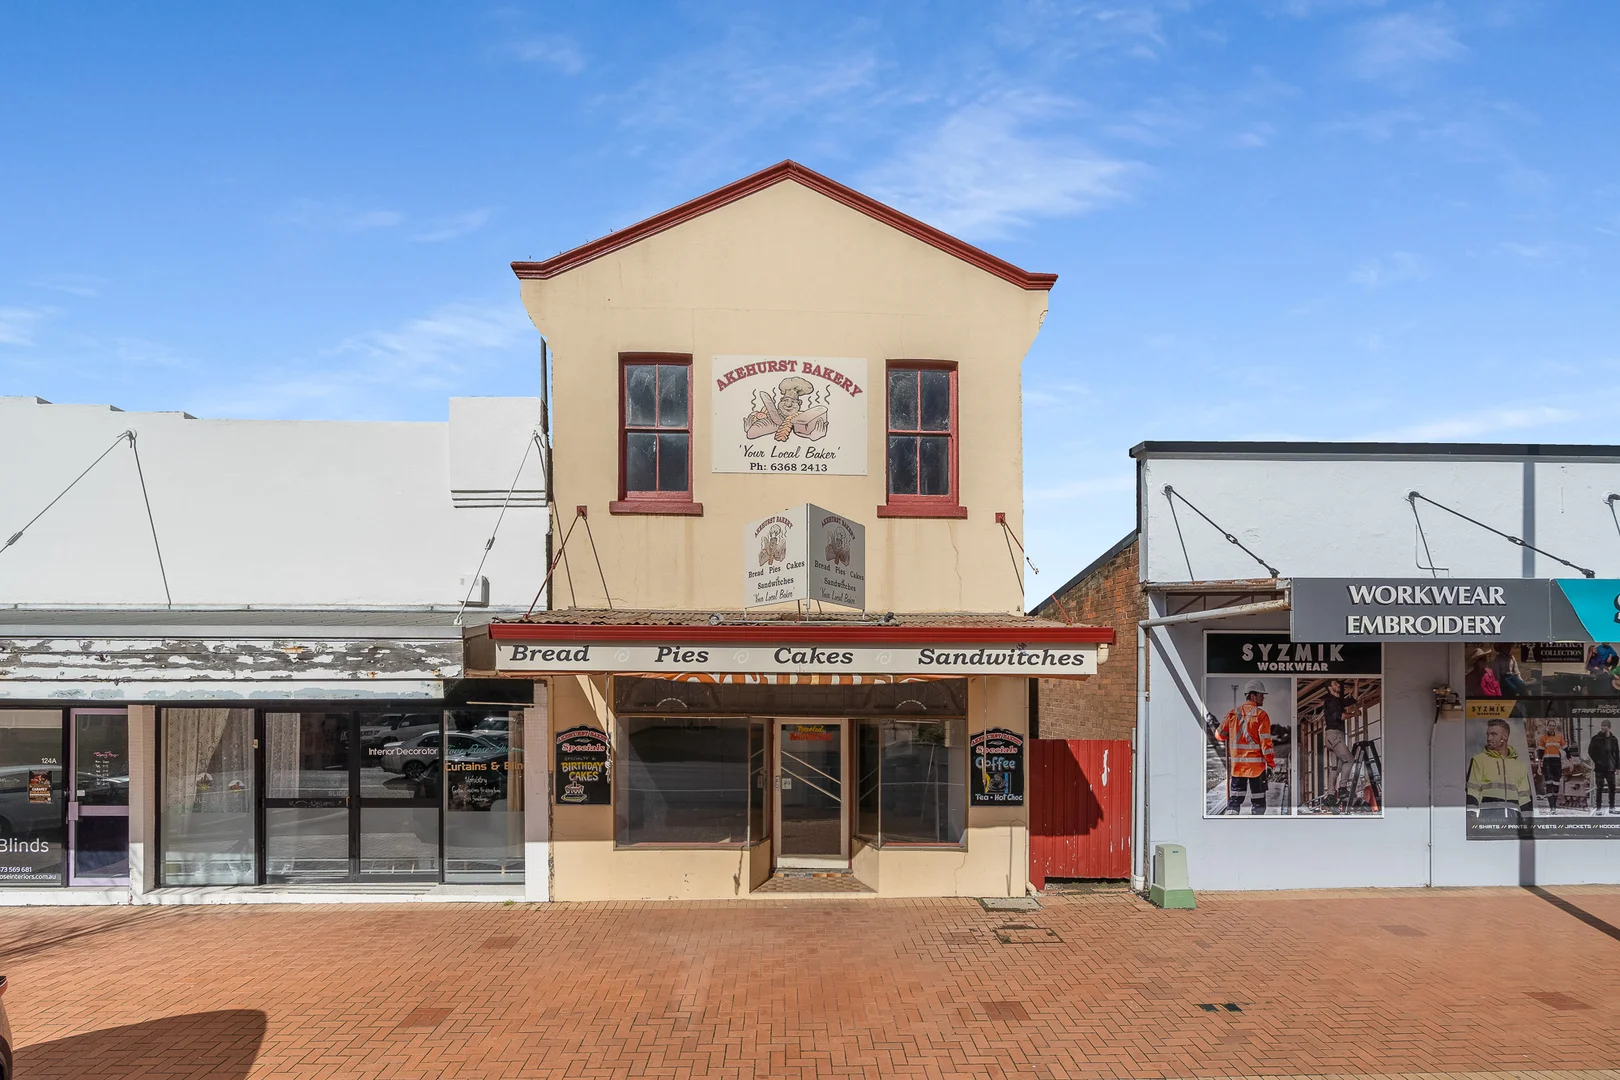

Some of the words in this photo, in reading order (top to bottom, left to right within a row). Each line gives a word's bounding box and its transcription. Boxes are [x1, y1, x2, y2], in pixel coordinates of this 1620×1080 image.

[716, 360, 798, 392] AKEHURST
[802, 361, 863, 397] BAKERY
[770, 445, 800, 458] Local
[750, 462, 767, 471] Ph:
[770, 462, 797, 472] 6368
[800, 464, 828, 472] 2413
[776, 516, 794, 530] BAKERY
[748, 569, 764, 578] Bread
[769, 566, 781, 574] Pies
[786, 560, 806, 570] Cakes
[814, 560, 830, 572] Bread
[850, 570, 864, 580] Cakes
[1347, 585, 1507, 605] WORKWEAR
[1346, 615, 1506, 636] EMBROIDERY
[510, 645, 590, 662] Bread
[655, 646, 709, 662] Pies
[774, 647, 854, 664] Cakes
[918, 648, 1085, 666] Sandwitches
[1242, 644, 1344, 662] SYZMIK
[1257, 662, 1328, 671] WORKWEAR
[562, 743, 605, 752] Specials
[445, 762, 487, 772] Curtains
[491, 762, 500, 770] &
[562, 762, 604, 772] BIRTHDAY
[976, 756, 1016, 770] Coffee
[569, 772, 599, 781] CAKES
[0, 838, 49, 852] Blinds
